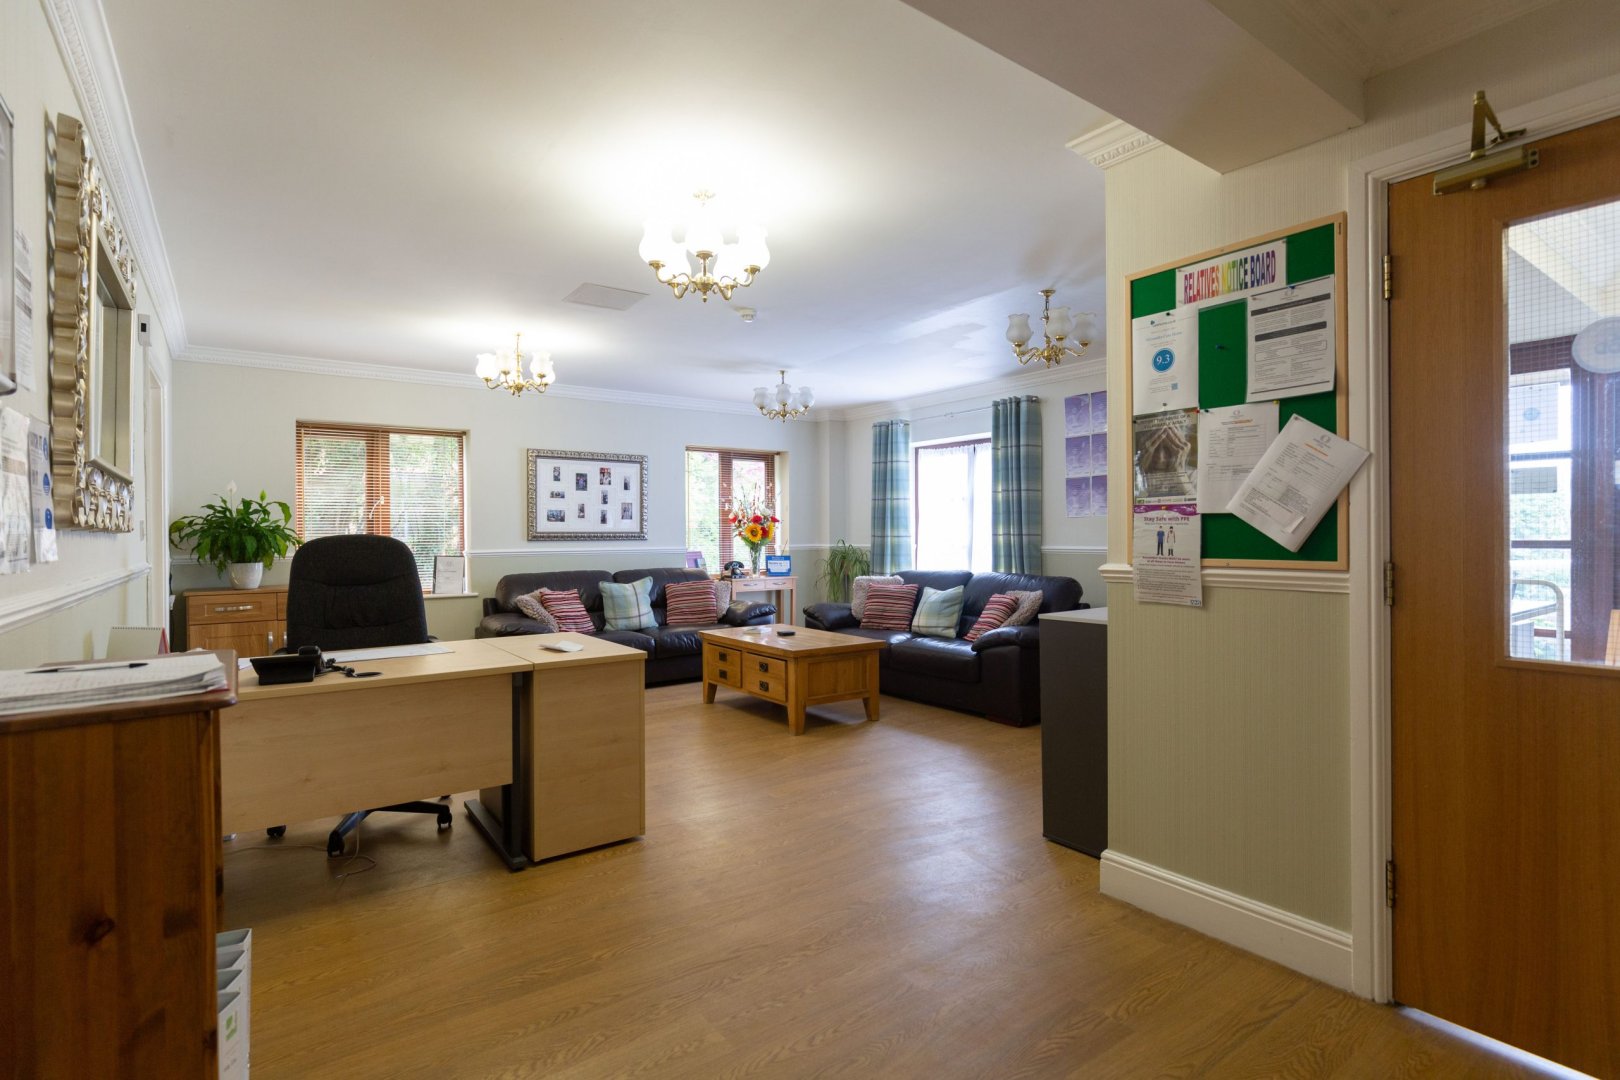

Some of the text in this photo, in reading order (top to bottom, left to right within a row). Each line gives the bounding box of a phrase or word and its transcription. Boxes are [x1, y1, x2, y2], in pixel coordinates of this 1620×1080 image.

[1184, 250, 1276, 304] RELATIVES NOTICE BOARD
[1156, 354, 1170, 365] 9.3
